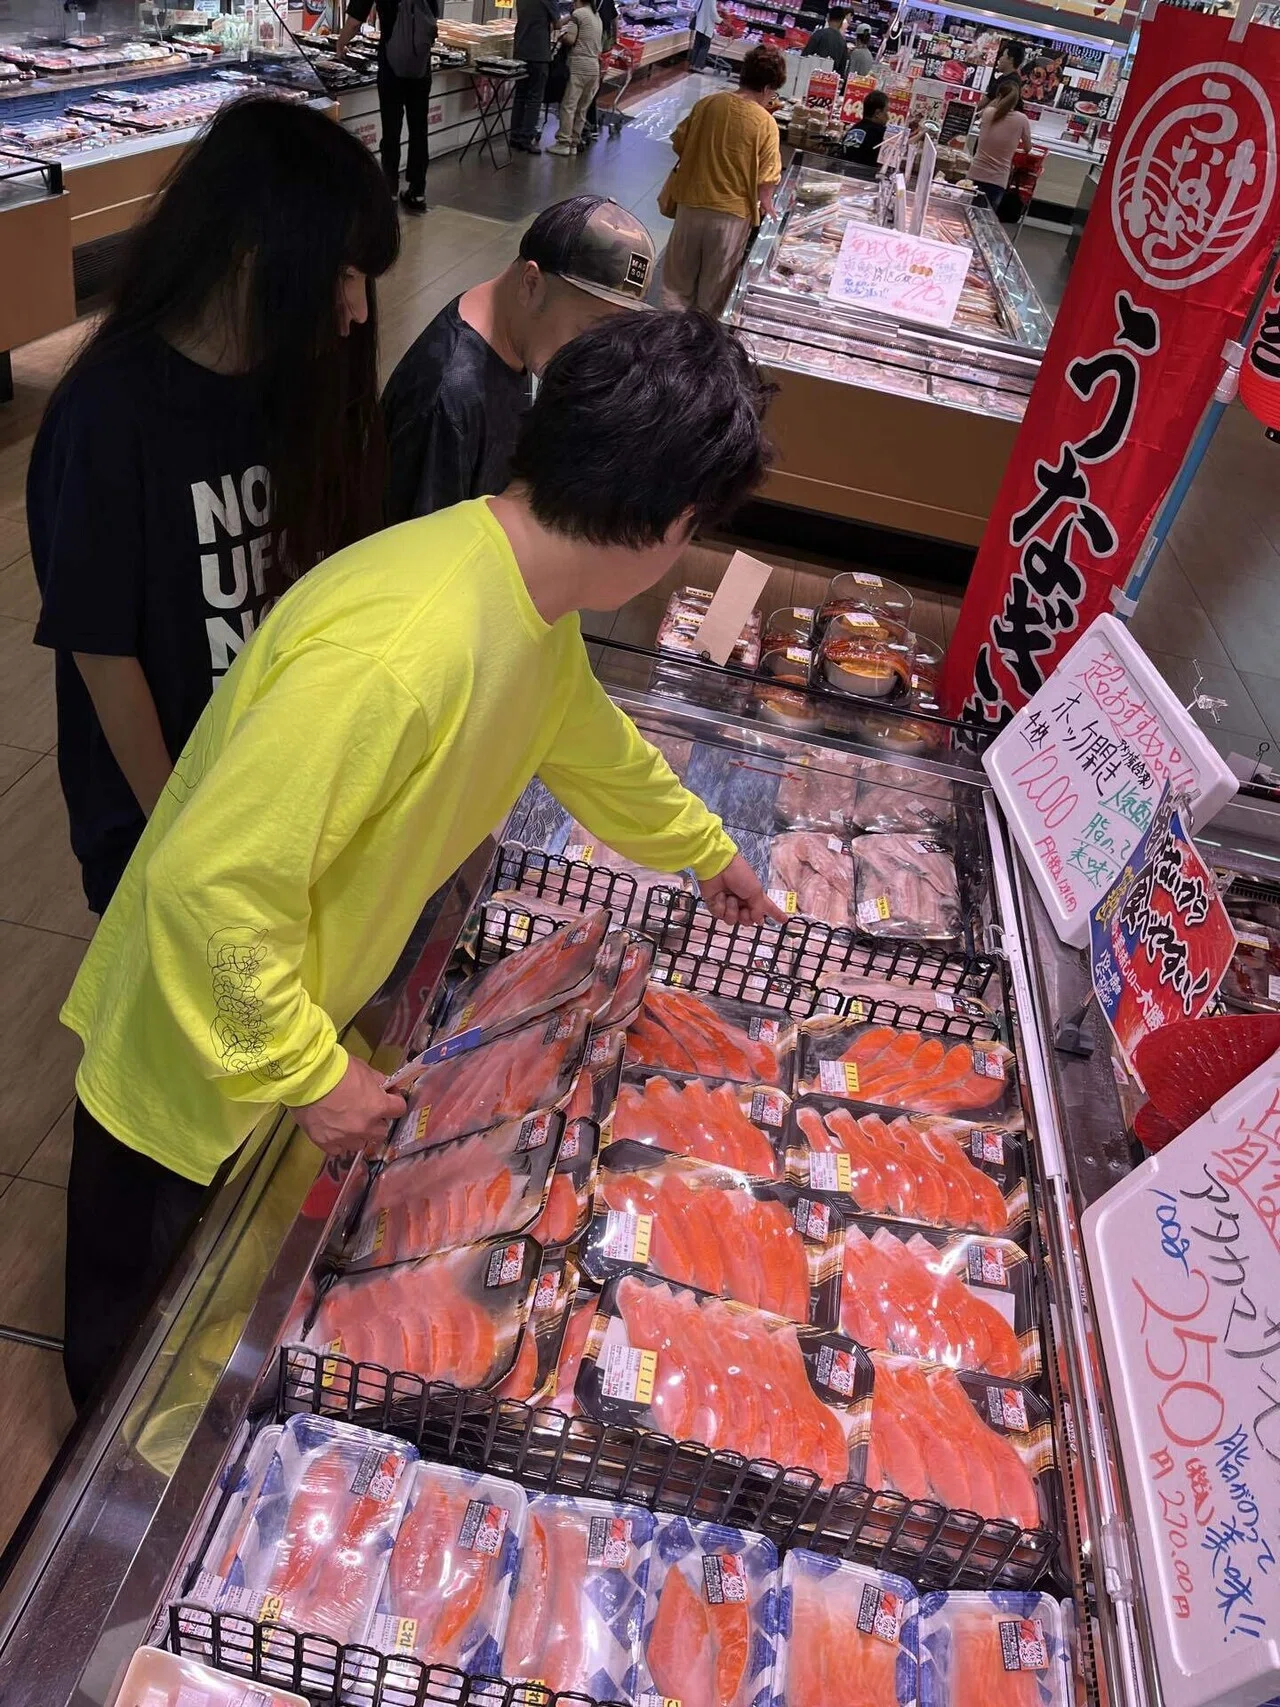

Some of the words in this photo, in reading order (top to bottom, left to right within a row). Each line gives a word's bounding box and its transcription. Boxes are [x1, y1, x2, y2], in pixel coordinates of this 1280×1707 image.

[191, 465, 275, 545] NO
[1011, 743, 1079, 830] 1200
[1051, 692, 1118, 797] ホッケ開き
[1132, 1267, 1225, 1448] 250
